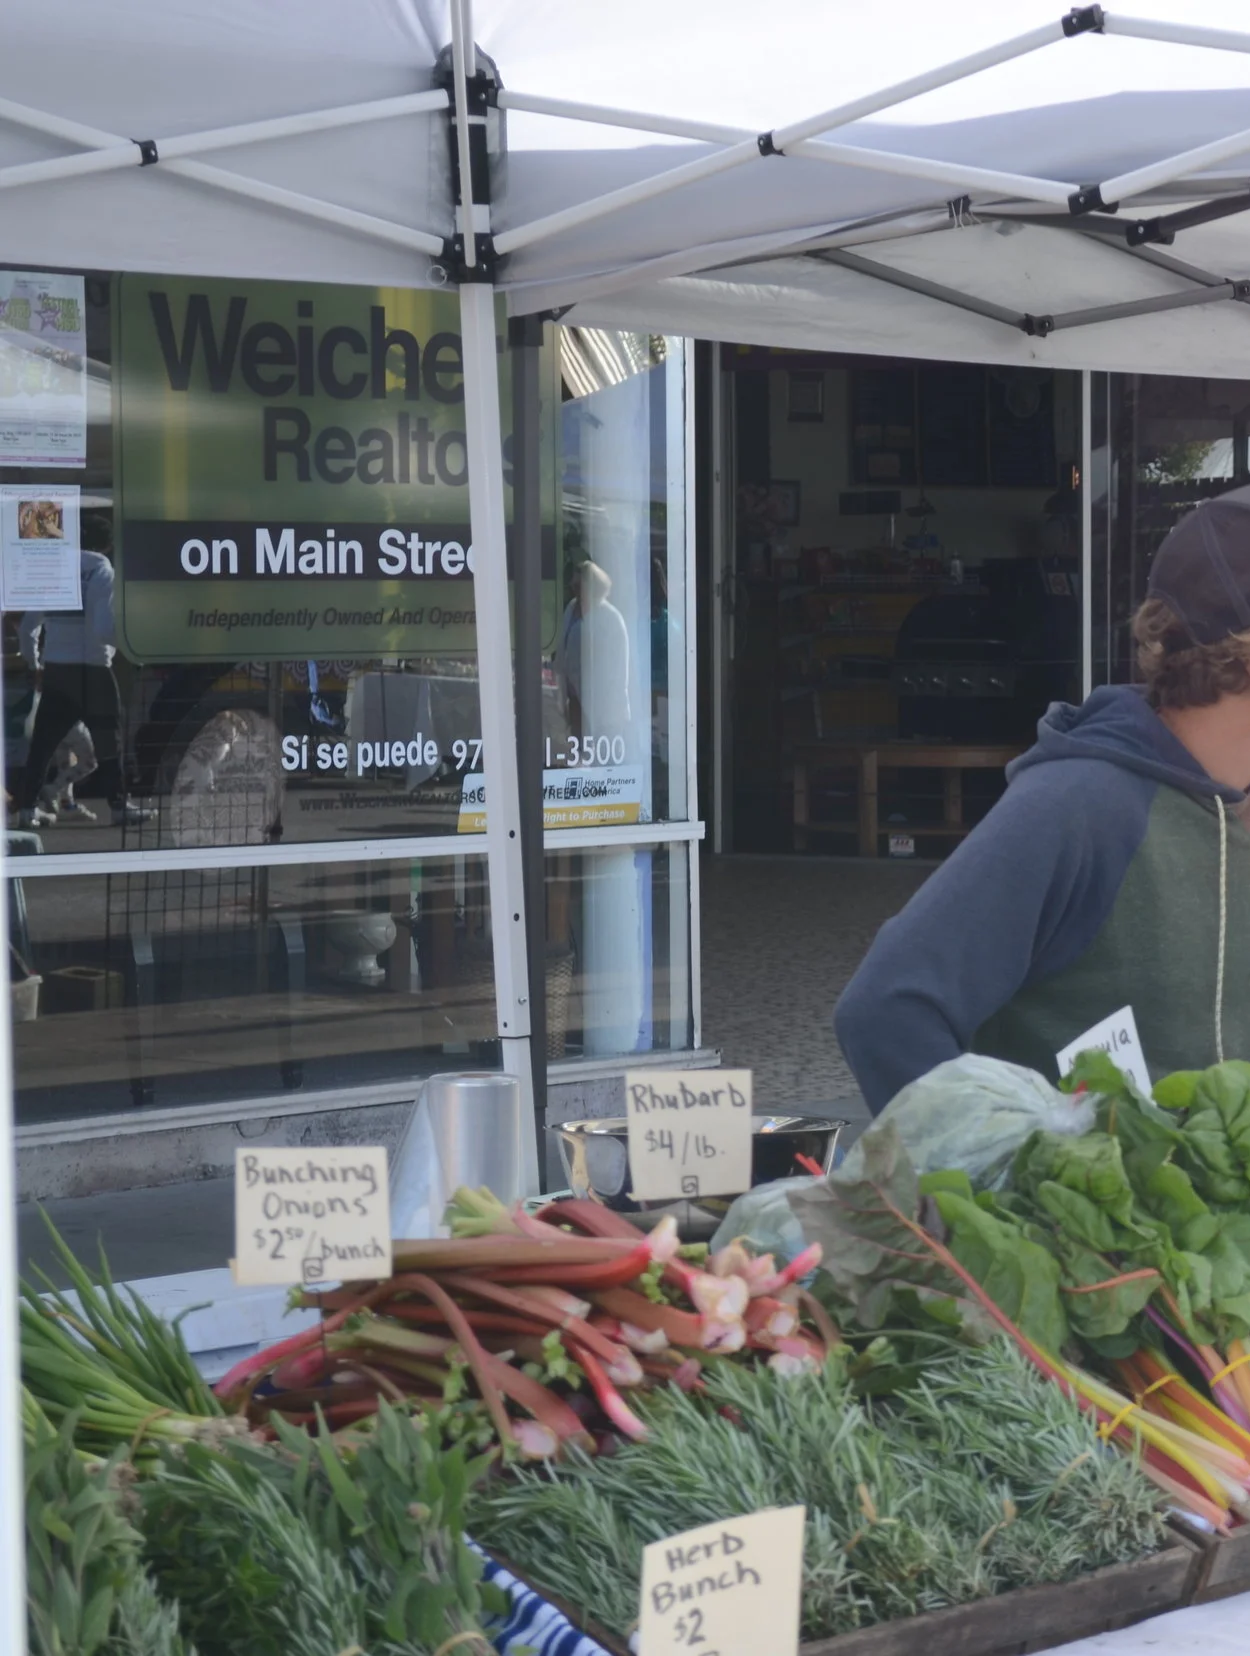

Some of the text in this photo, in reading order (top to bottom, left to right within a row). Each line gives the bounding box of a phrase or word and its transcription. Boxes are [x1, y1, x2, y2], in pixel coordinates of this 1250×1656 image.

[149, 291, 464, 404] Weiche
[263, 406, 467, 486] Realto
[180, 538, 238, 575] on
[255, 527, 363, 575] Main
[187, 604, 477, 632] Independently Owned And Opera
[281, 735, 308, 771] Sí
[316, 739, 348, 768] se
[357, 733, 438, 776] puede
[452, 738, 484, 770] 97
[584, 777, 636, 787] Home Partners
[569, 811, 579, 821] to
[582, 808, 625, 821] Purchase
[630, 1080, 746, 1113] Rhubarb
[243, 1155, 378, 1197] Bunching
[263, 1191, 369, 1220] Onions
[665, 1531, 745, 1573] Herb
[651, 1560, 761, 1614] Bunch
[674, 1607, 706, 1646] $2
